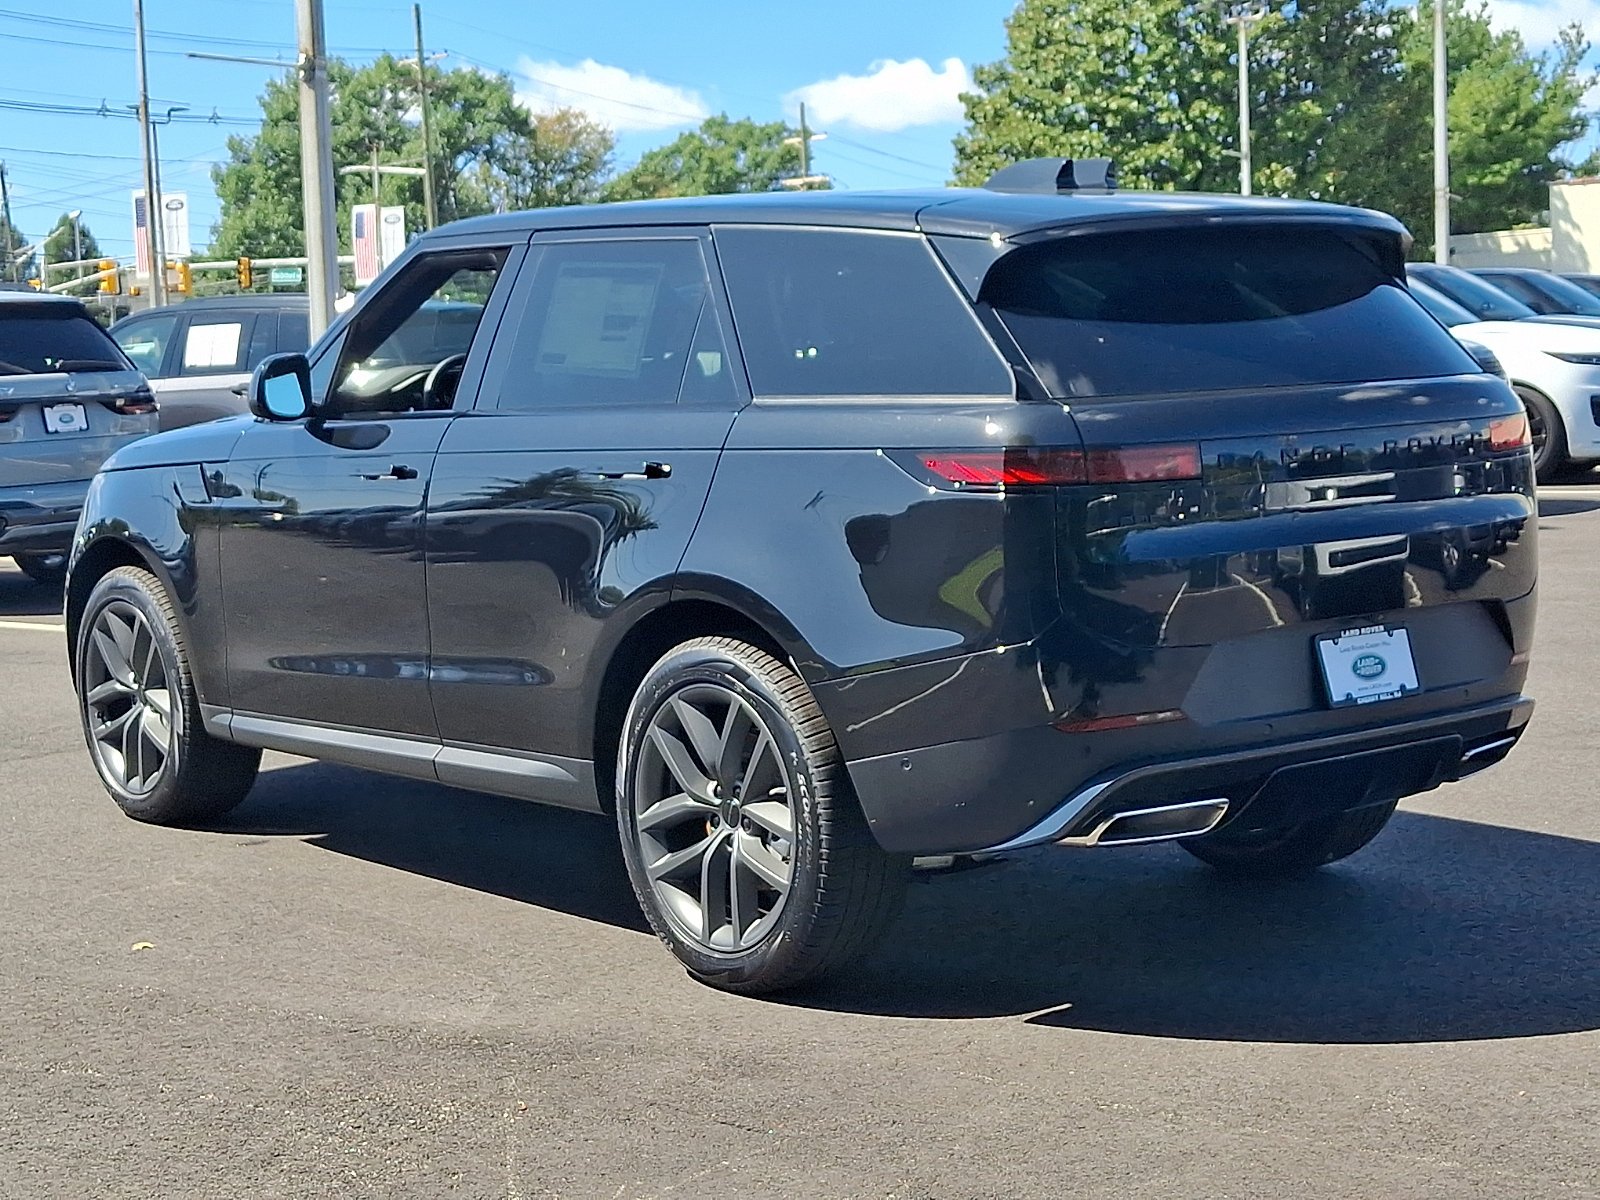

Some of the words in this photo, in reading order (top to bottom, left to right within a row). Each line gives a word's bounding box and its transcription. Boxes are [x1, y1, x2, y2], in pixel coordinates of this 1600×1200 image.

[1341, 628, 1360, 637] LAND
[1361, 625, 1384, 635] ROVER
[1357, 657, 1375, 667] LAND
[1360, 664, 1382, 675] ROVER
